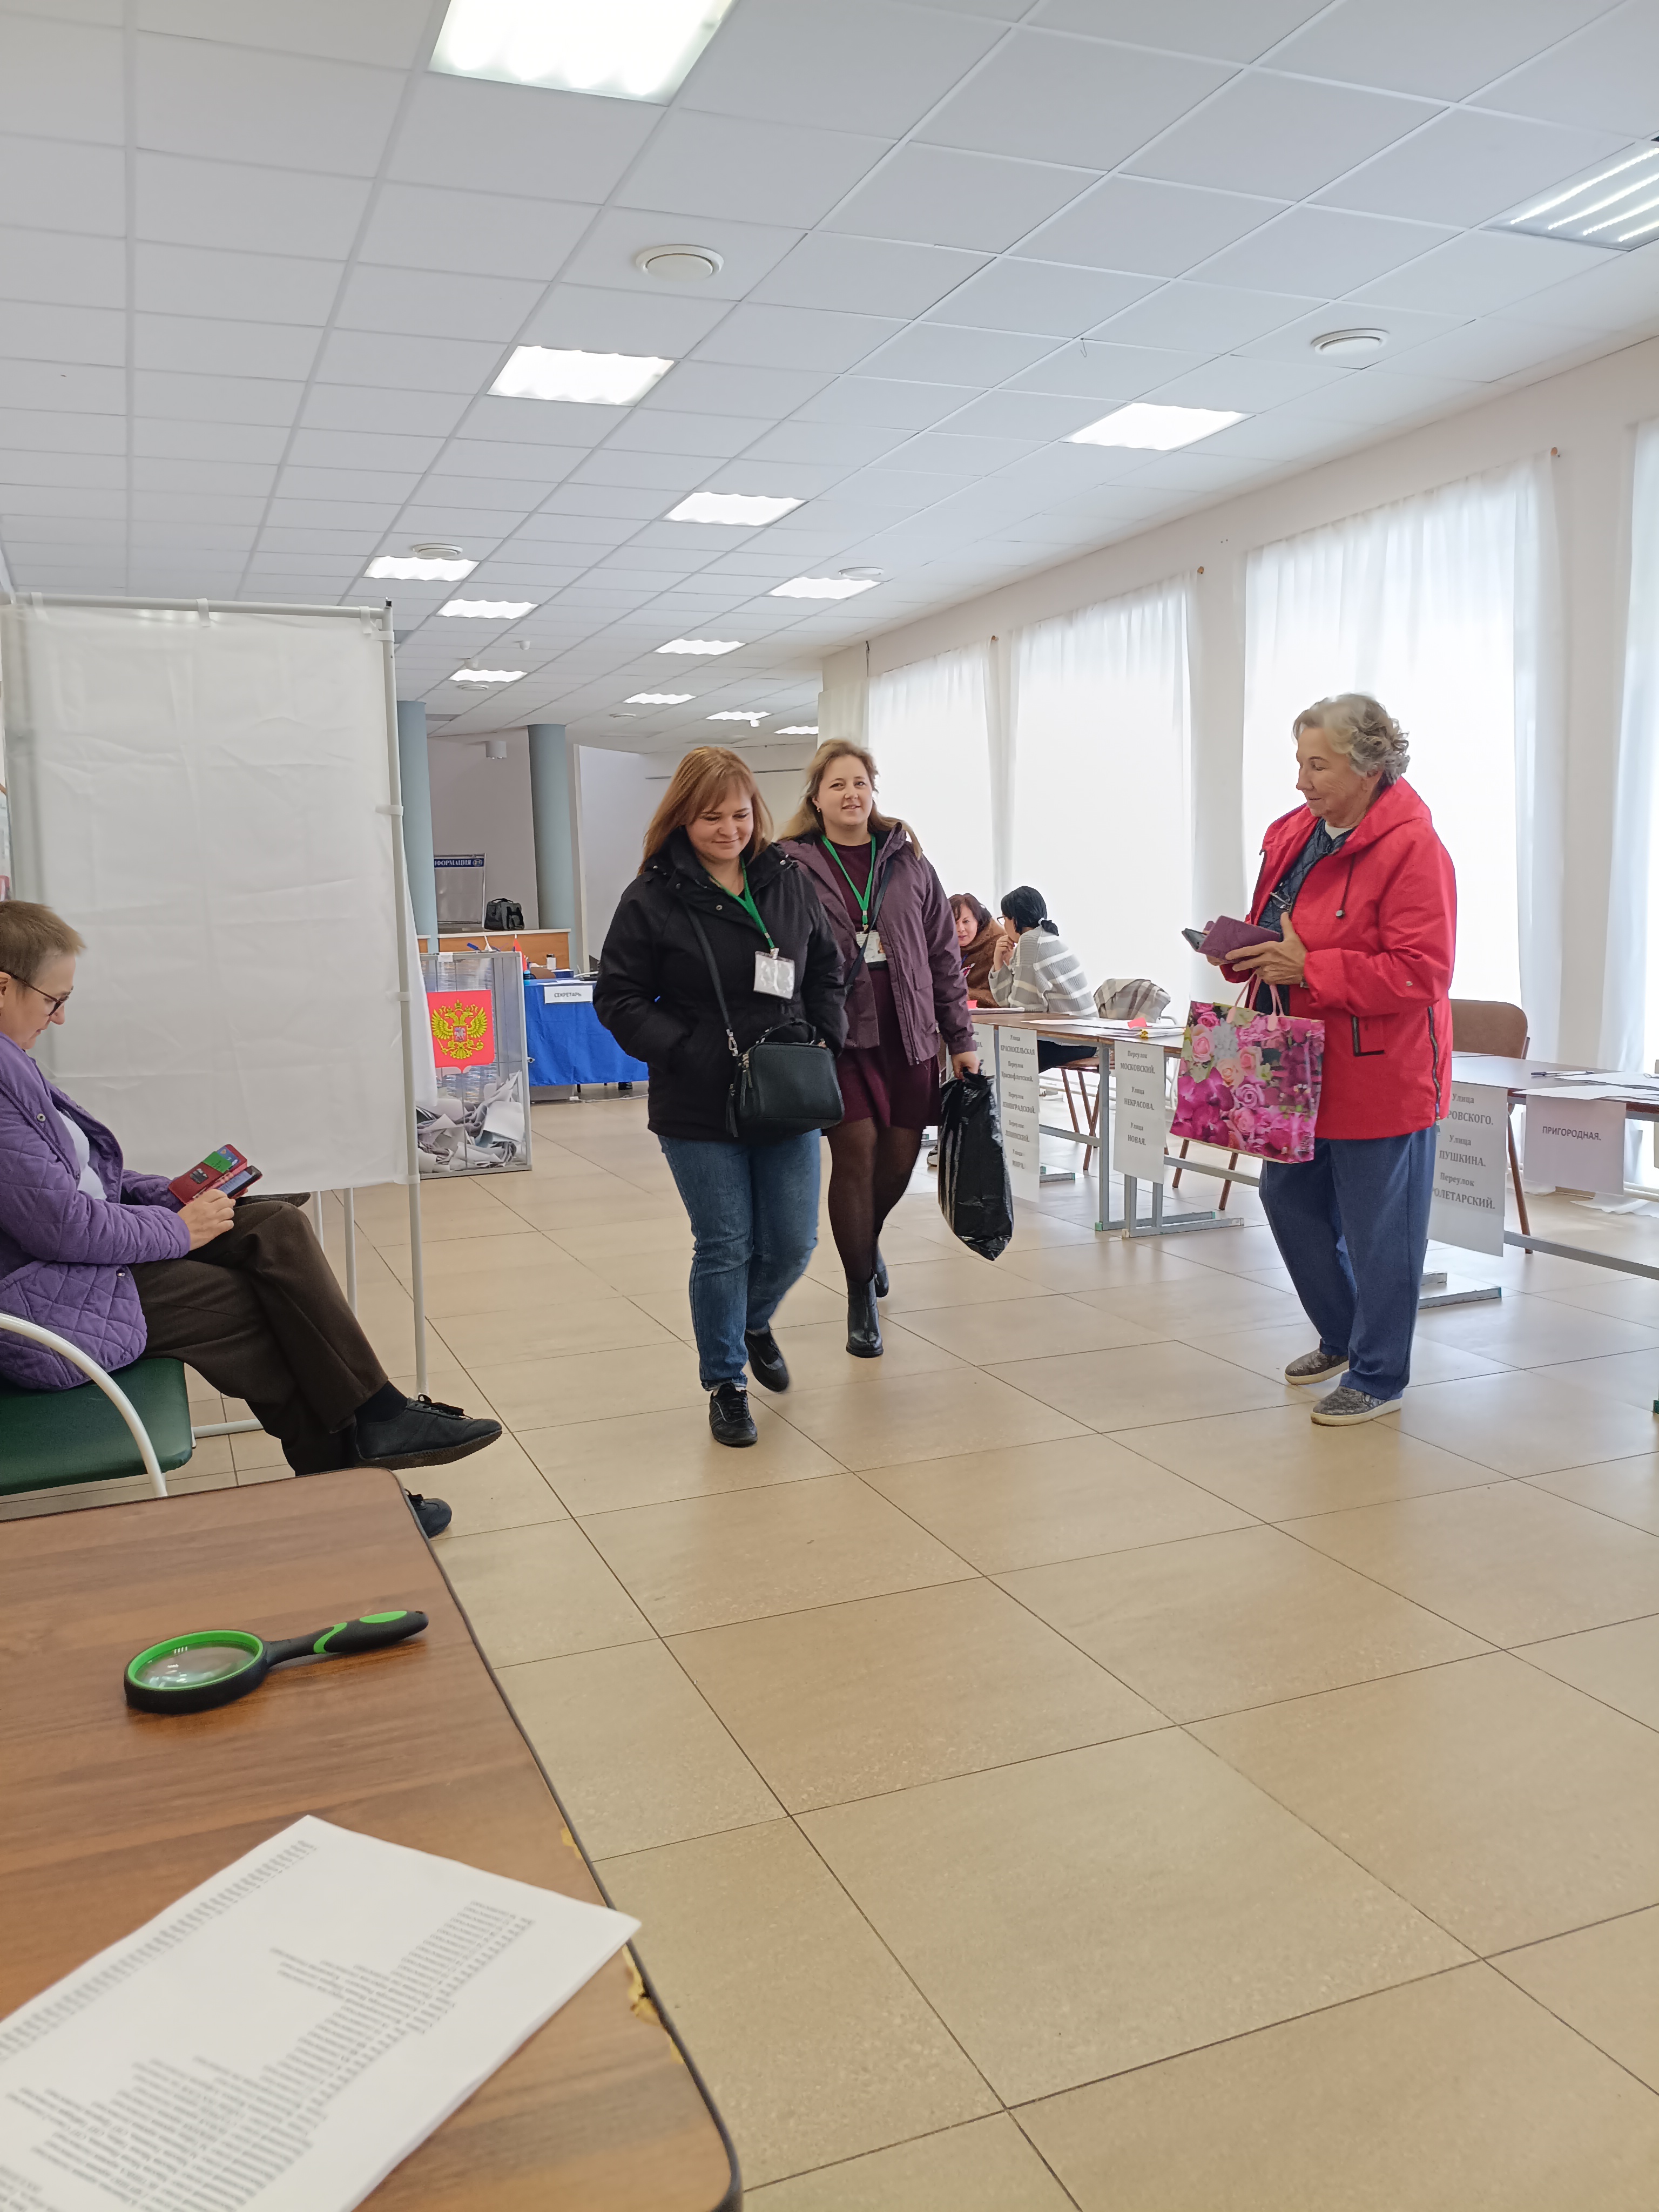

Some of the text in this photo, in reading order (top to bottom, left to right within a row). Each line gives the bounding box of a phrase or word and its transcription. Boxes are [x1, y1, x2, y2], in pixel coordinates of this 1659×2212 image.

[1127, 1050, 1148, 1059] Переулок
[1120, 1062, 1155, 1074] МОСКОВСКИЙ.
[1131, 1087, 1144, 1095] Улица
[1124, 1098, 1155, 1110] НЕКРАСОВА.
[1452, 1093, 1474, 1104] Улица
[1447, 1110, 1494, 1125] РОВСКОГО.
[1130, 1122, 1144, 1131] Улица
[1542, 1126, 1601, 1141] ПРИГОРОДНАЯ.
[1128, 1135, 1147, 1145] НОВАЯ.
[1449, 1135, 1472, 1146] Улица
[1439, 1150, 1486, 1166] ПУШКИНА.
[1440, 1172, 1475, 1186] Переулок
